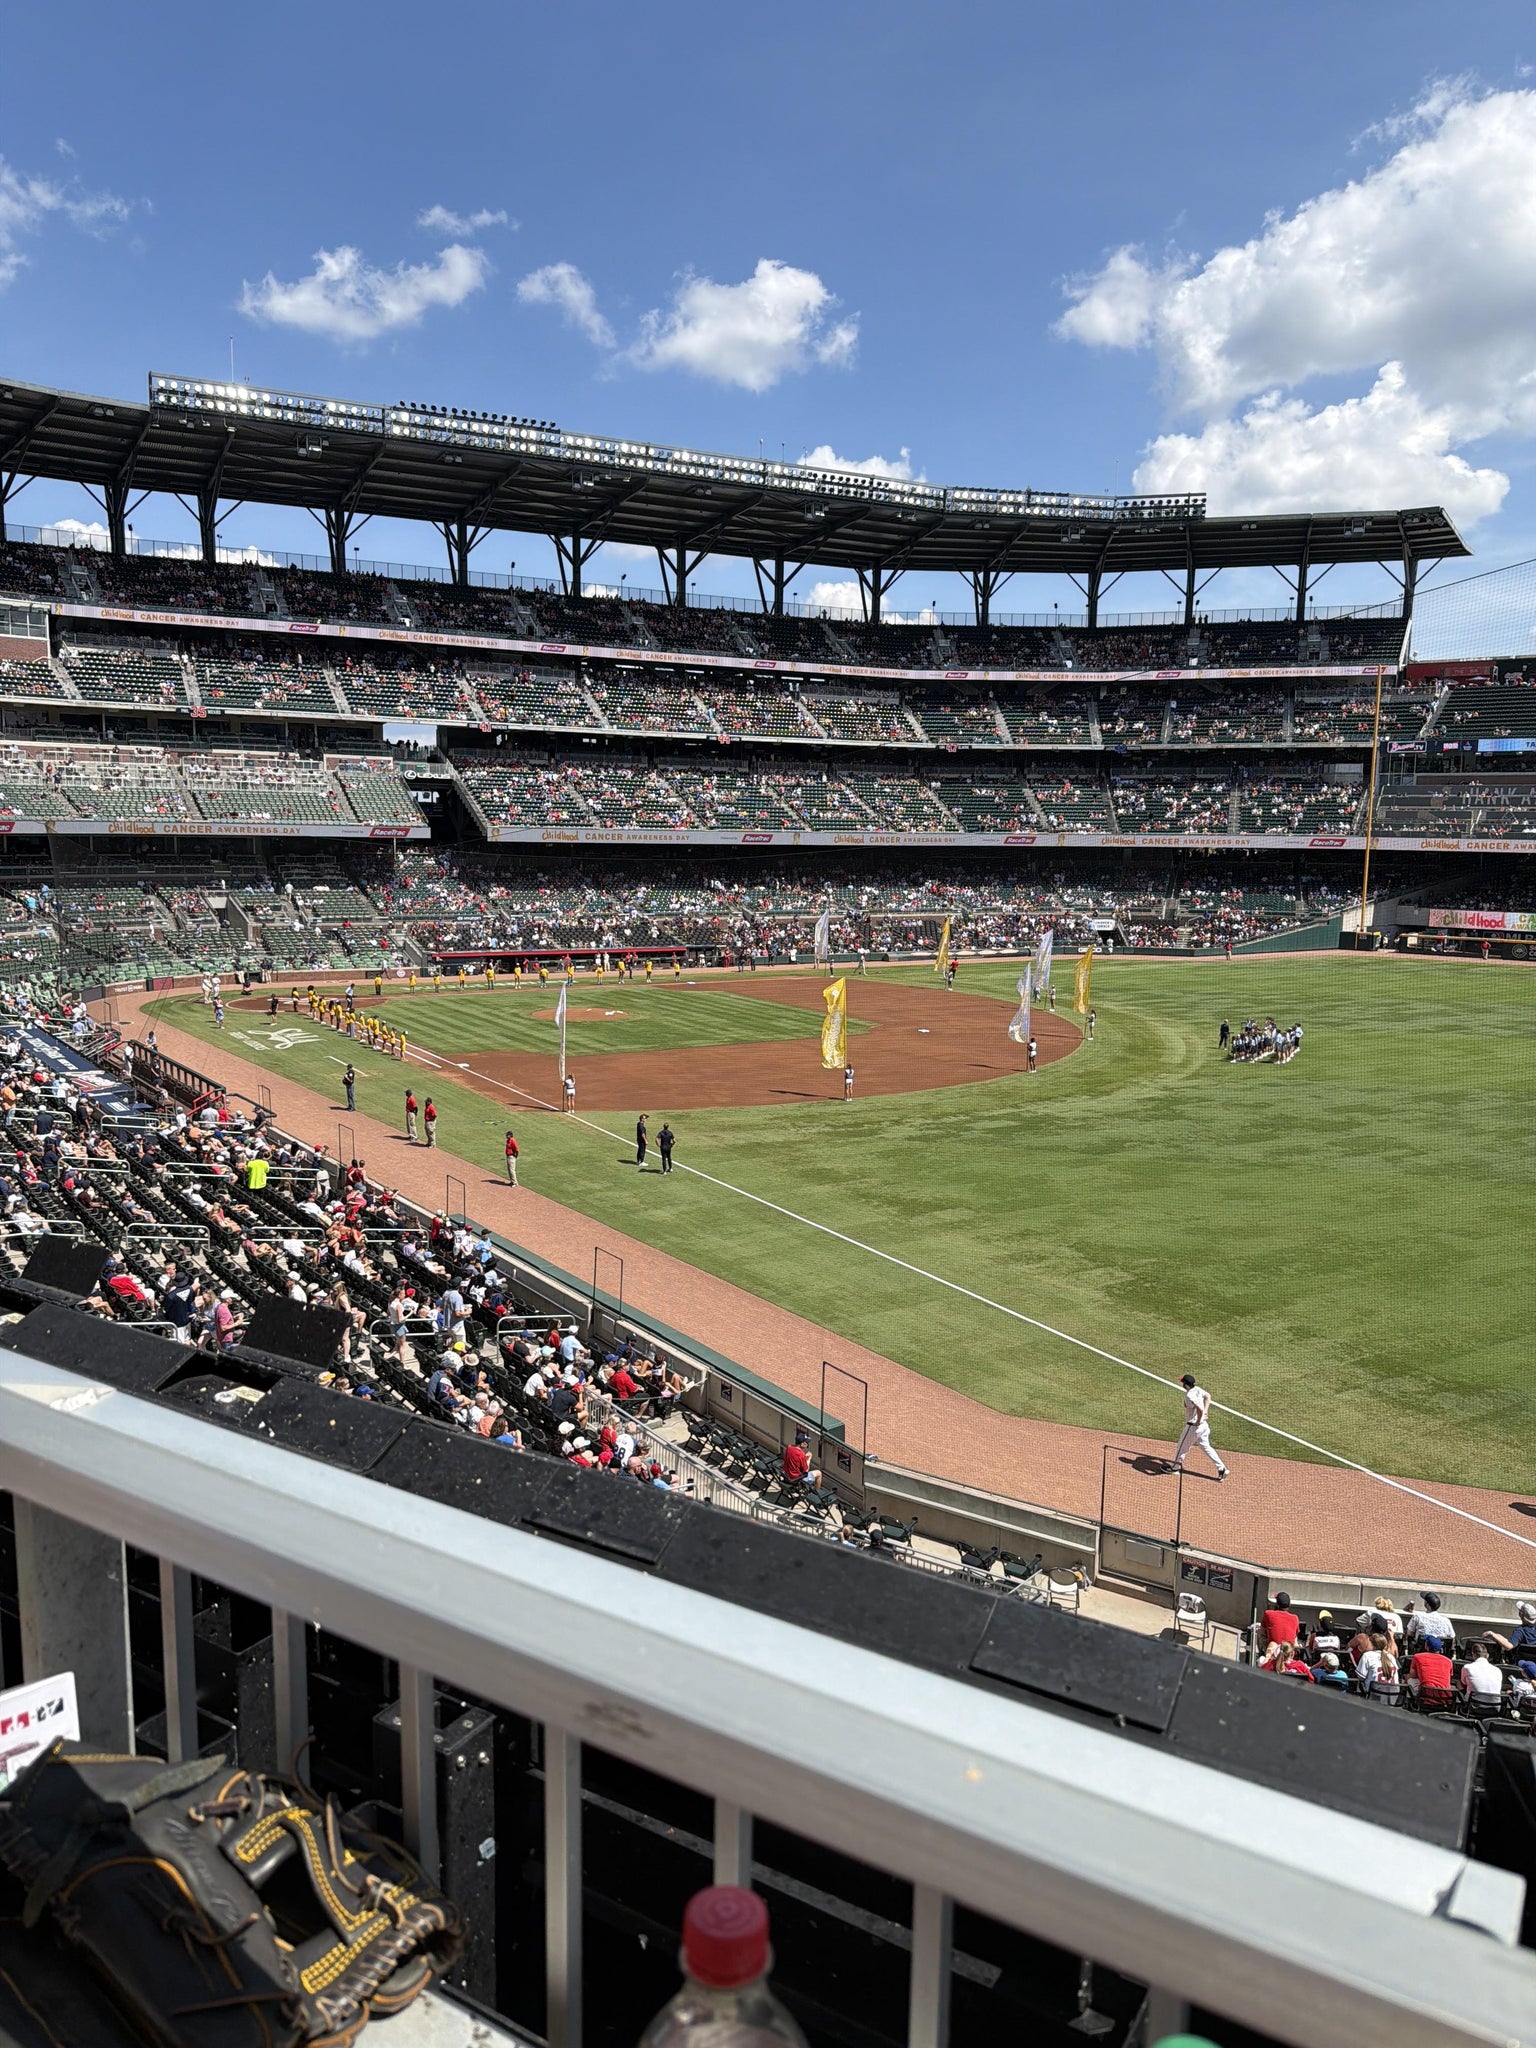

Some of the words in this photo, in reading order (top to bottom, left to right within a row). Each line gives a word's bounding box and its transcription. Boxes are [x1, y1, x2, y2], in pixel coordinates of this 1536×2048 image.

[140, 613, 176, 623] CANCER
[179, 617, 223, 625] AWARENESS
[413, 634, 444, 643] CANCER
[645, 653, 672, 661] CANCER
[845, 667, 868, 675] CANCER
[190, 706, 207, 718] 35
[479, 721, 492, 733] 41
[164, 824, 212, 834] CANCER
[217, 826, 279, 835] AWARENESS
[585, 833, 623, 841] CANCER
[869, 836, 900, 844] CANCER
[1006, 836, 1034, 844] RaceTrac
[1312, 838, 1344, 846] RaceTrac
[1467, 842, 1510, 850] CANCER
